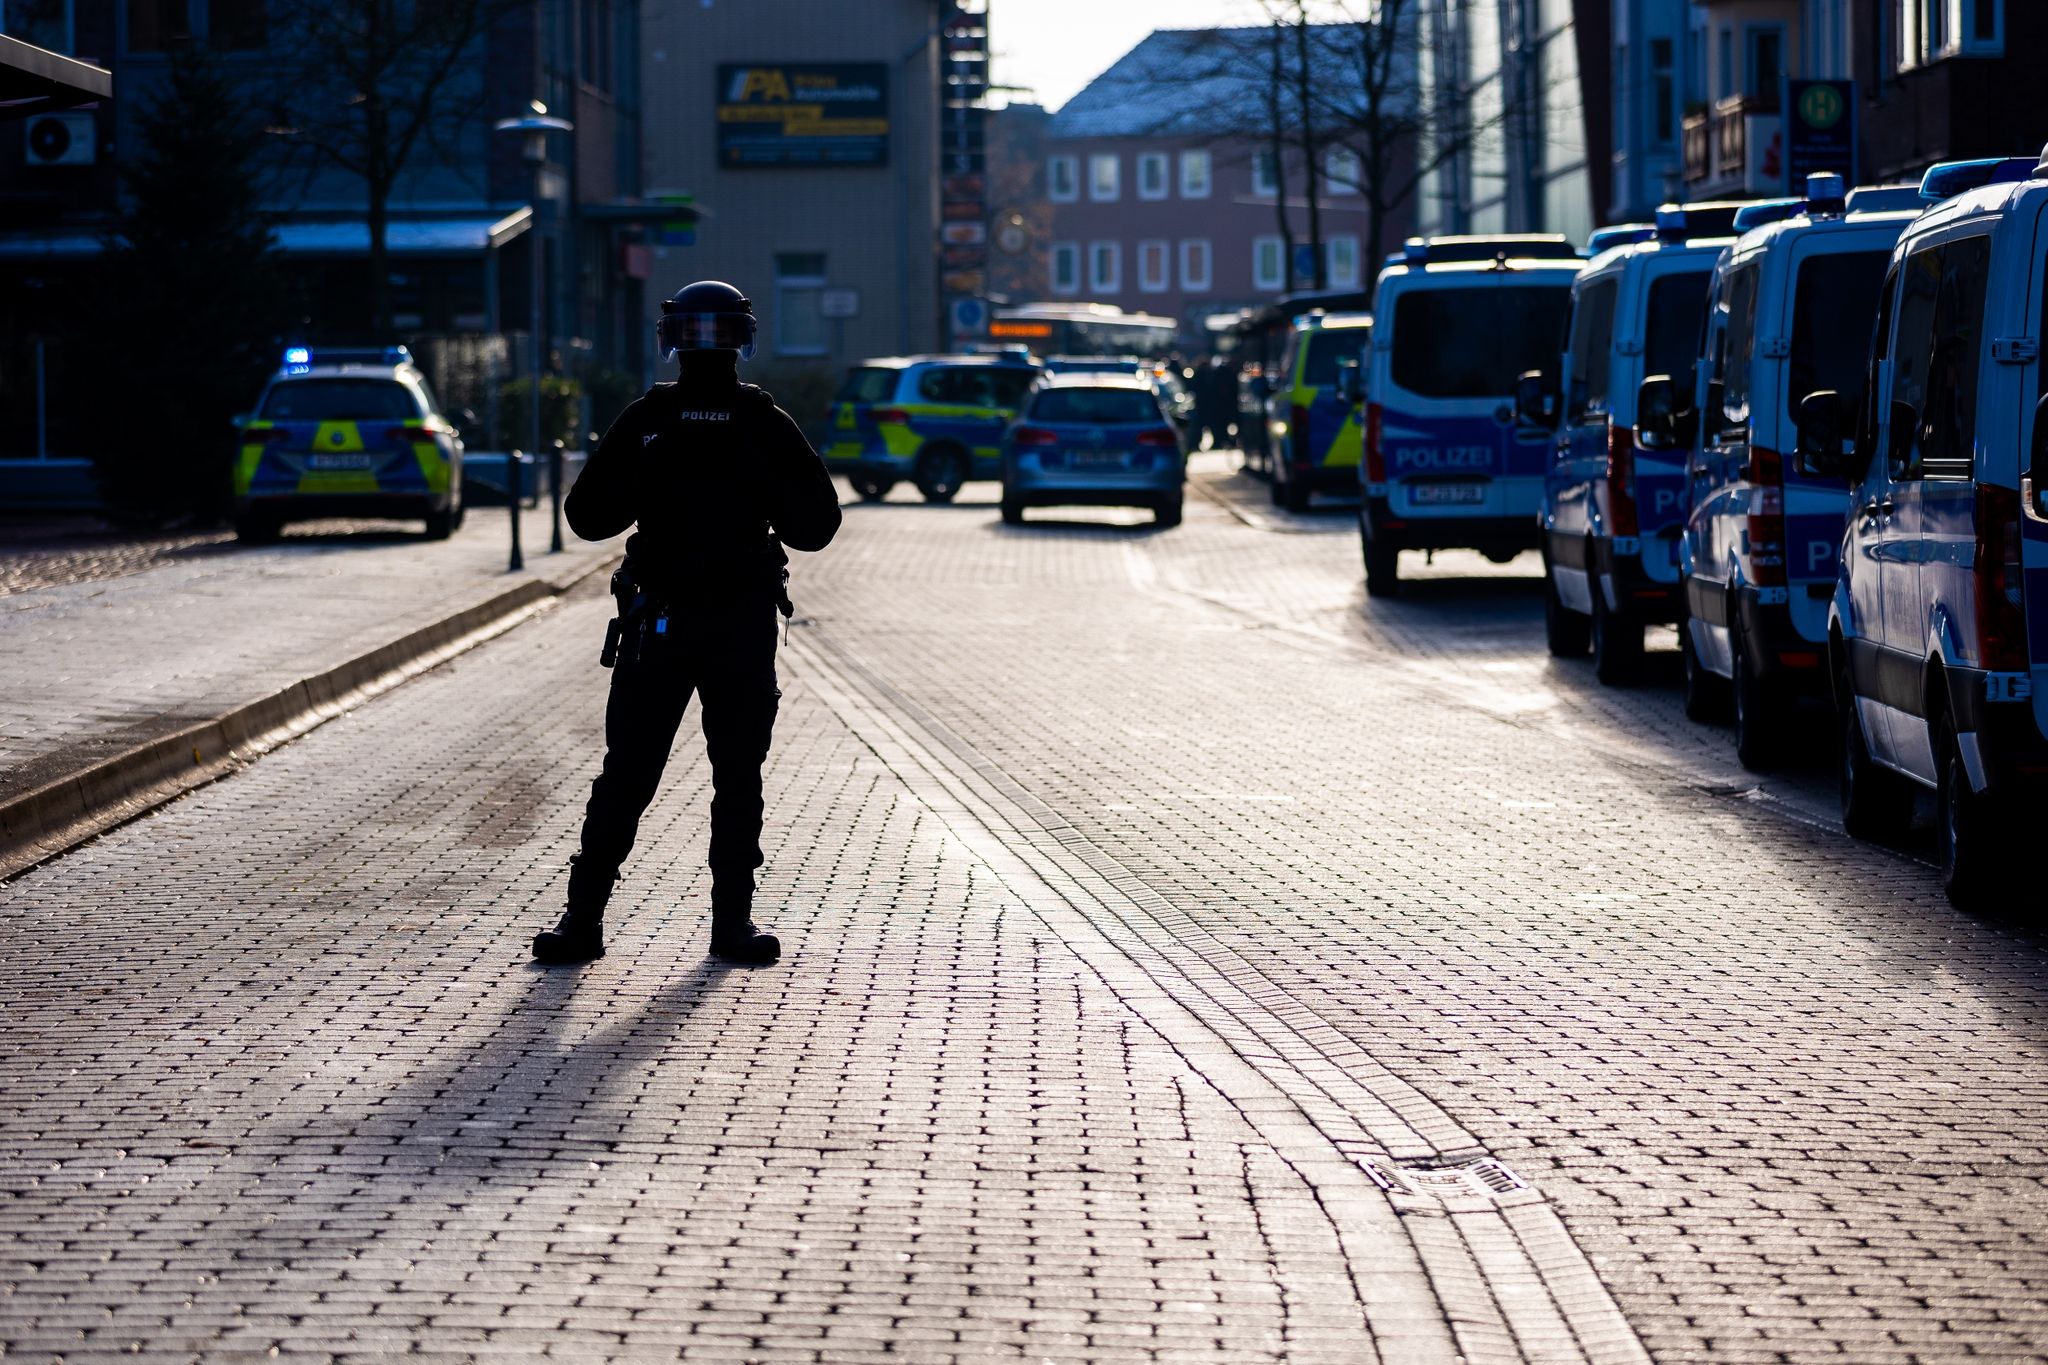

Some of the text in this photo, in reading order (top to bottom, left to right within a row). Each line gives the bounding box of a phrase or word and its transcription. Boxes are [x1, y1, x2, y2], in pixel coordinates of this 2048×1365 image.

[681, 411, 730, 421] POLIZEI
[1395, 447, 1492, 468] POLIZEI
[1808, 541, 1841, 571] P
